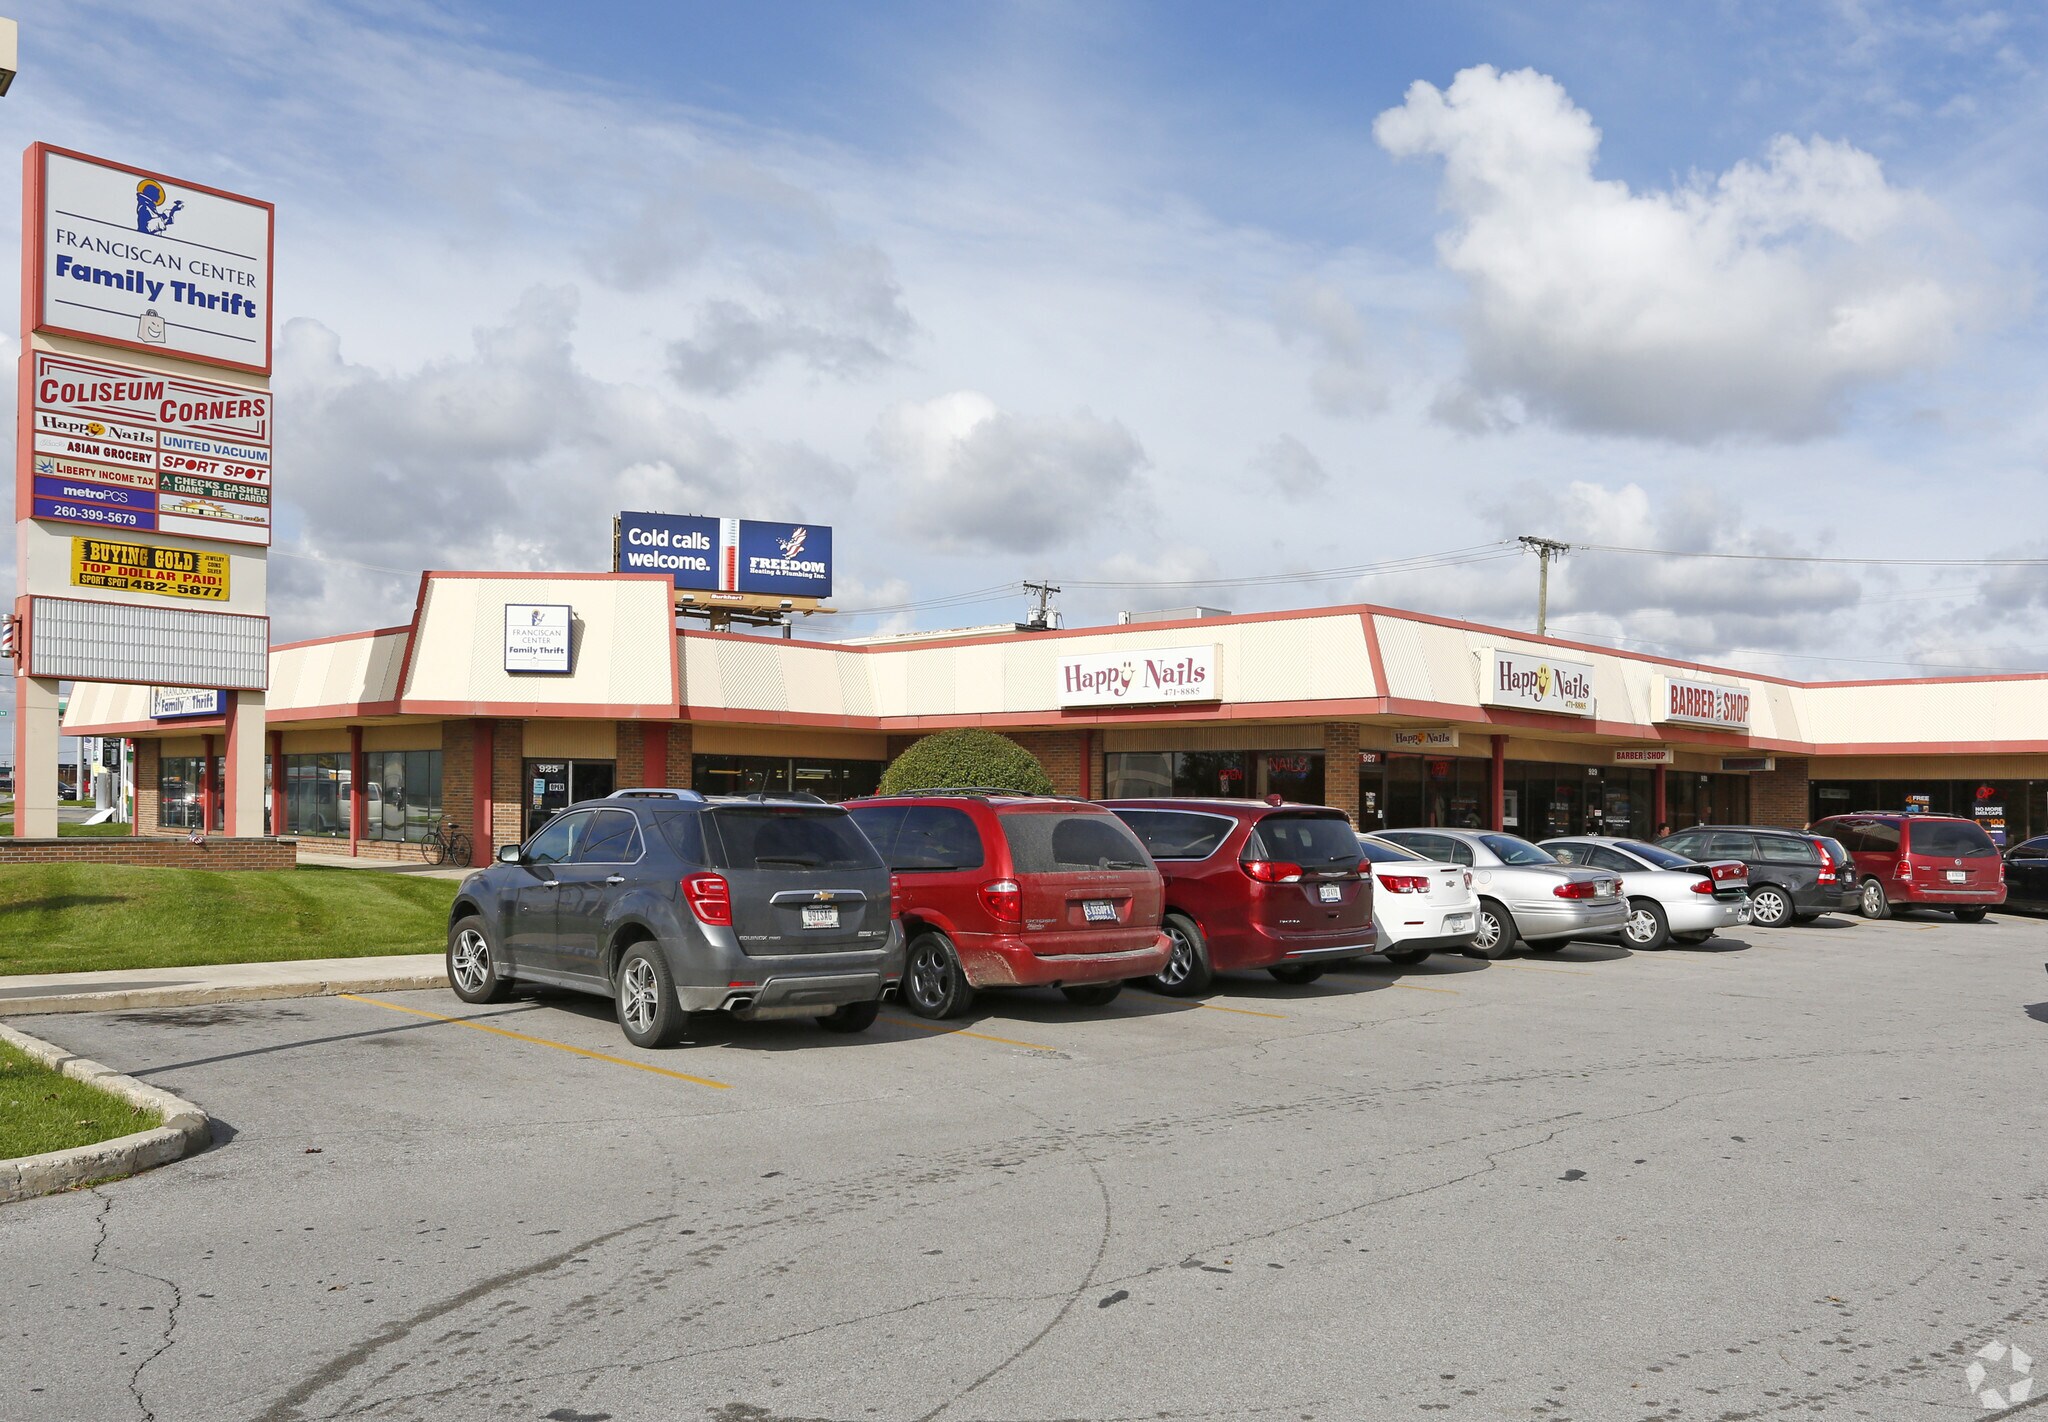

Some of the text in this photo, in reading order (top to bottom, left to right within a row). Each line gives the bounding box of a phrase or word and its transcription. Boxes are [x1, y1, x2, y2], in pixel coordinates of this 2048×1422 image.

[56, 228, 257, 288] FRANCISCAN CENTER
[56, 254, 256, 318] Family Thrift
[40, 379, 164, 403] COLISEUM
[160, 399, 265, 423] CORNERS
[42, 416, 154, 443] Happy Nails
[67, 441, 100, 455] ASIAN
[103, 447, 152, 464] GROCERY
[163, 436, 268, 461] UNITED VACUUM
[56, 462, 154, 486] LIBERTY INCOME TAX
[162, 455, 267, 481] SPORT SPOT
[63, 486, 128, 503] metroPCS
[174, 476, 268, 497] CHECKS CASHED
[174, 484, 268, 504] LOANS DEBIT CARDS
[54, 505, 137, 525] 260-399-5679
[628, 528, 711, 550] Cold calls
[89, 542, 193, 571] BUYING GOLD
[204, 555, 225, 563] JEWELRY
[628, 550, 711, 571] welcome.
[750, 557, 825, 573] FREEDOM
[80, 562, 223, 586] TOP DOLLAR PAID!
[750, 568, 775, 576] Heating
[782, 570, 813, 579] Plumbing
[81, 574, 223, 598] SPORT SPOT 482-5877
[509, 646, 538, 655] Family
[1064, 658, 1206, 697] Happy Nails
[1499, 661, 1590, 702] Happy Nails
[1164, 687, 1200, 696] 471-8885
[161, 693, 214, 714] Family Thrift
[1565, 700, 1587, 710] 471-8885
[1671, 684, 1749, 723] BARBER SHOP
[1395, 732, 1450, 746] Happy Nails
[1268, 757, 1308, 773] NAILS
[1362, 754, 1376, 763] 927
[1616, 751, 1666, 760] BARBER SHOP
[539, 765, 559, 773] 925
[1218, 769, 1243, 781] OPEN
[1588, 768, 1598, 776] 929
